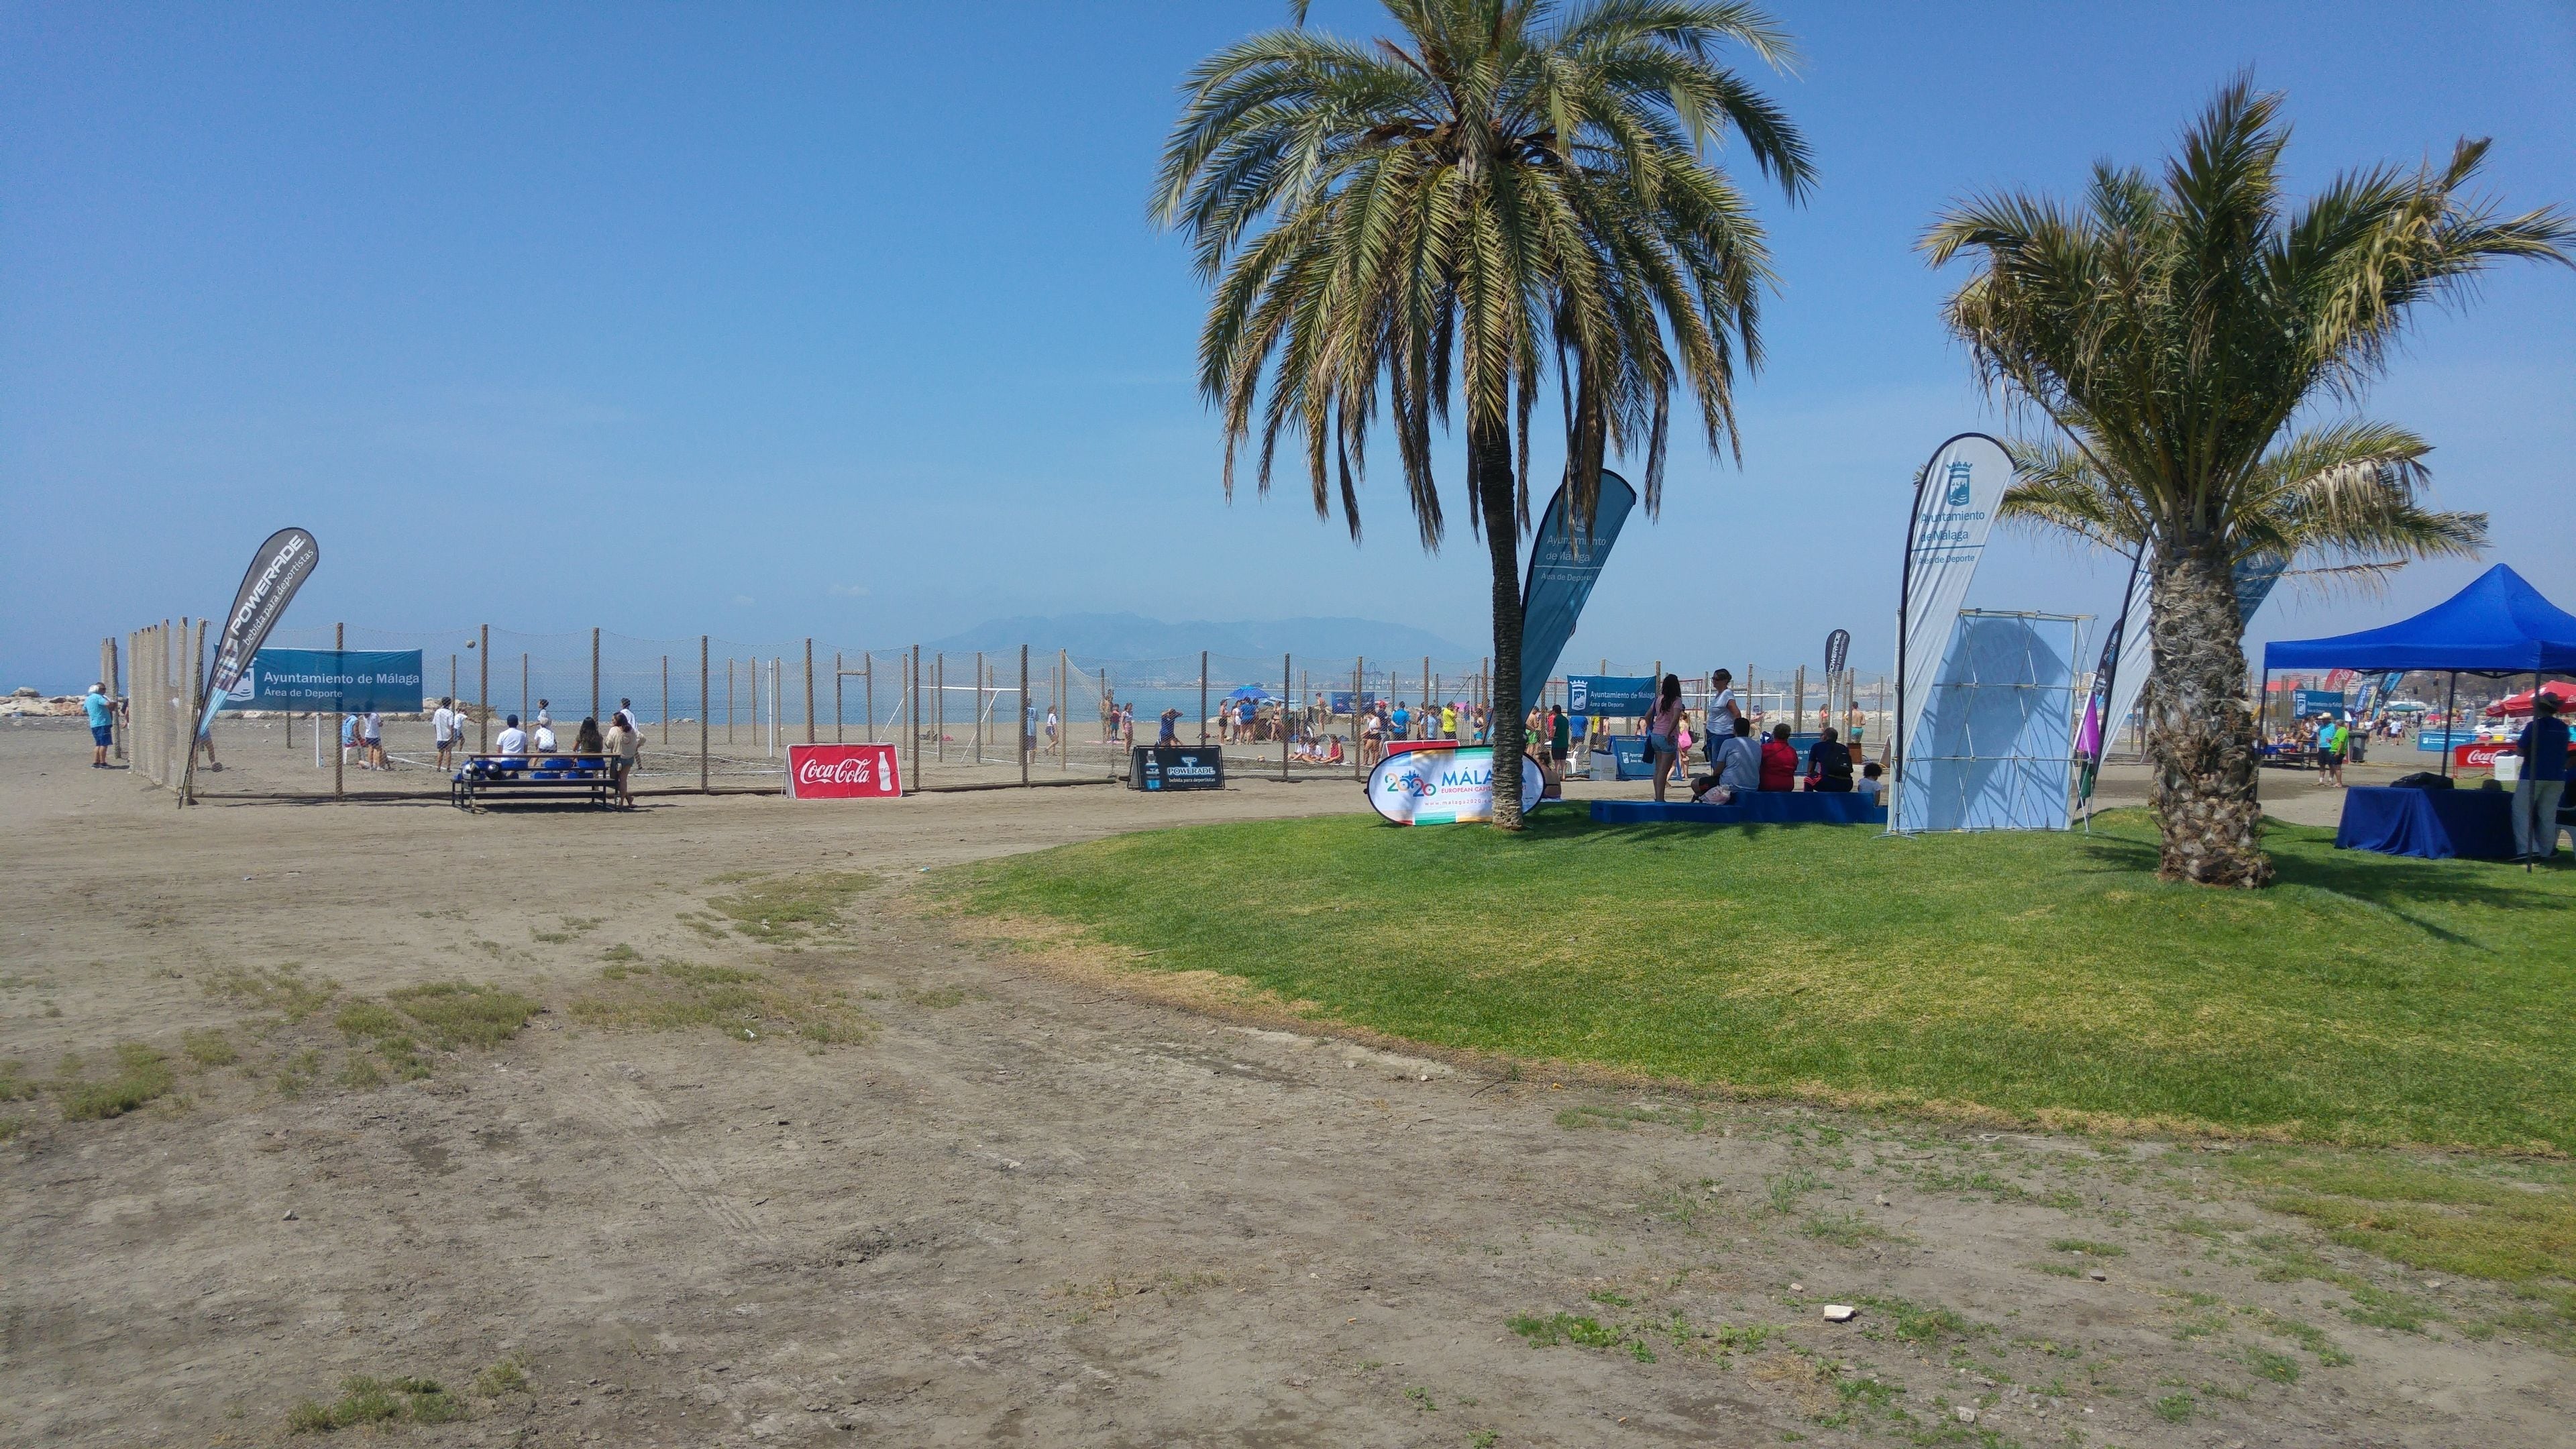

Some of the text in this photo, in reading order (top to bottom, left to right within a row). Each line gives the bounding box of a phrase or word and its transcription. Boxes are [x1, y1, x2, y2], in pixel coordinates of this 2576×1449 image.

[1921, 511, 1985, 524] Ayuntamiento
[1921, 529, 1968, 542] de Málaga
[1546, 551, 1557, 560] de
[1917, 556, 1933, 565] Área
[1946, 555, 1975, 564] Deporte
[230, 535, 305, 636] POWERADE
[243, 549, 314, 646] bebida para deportistas
[264, 672, 419, 685] Ayuntamiento de Málaga
[264, 686, 343, 698] Área de Deporte
[1590, 691, 1629, 699] Ayuntamiento
[2467, 749, 2508, 764] Coca-C
[800, 759, 872, 784] Coca-Cola
[1167, 767, 1214, 775] POWERADE
